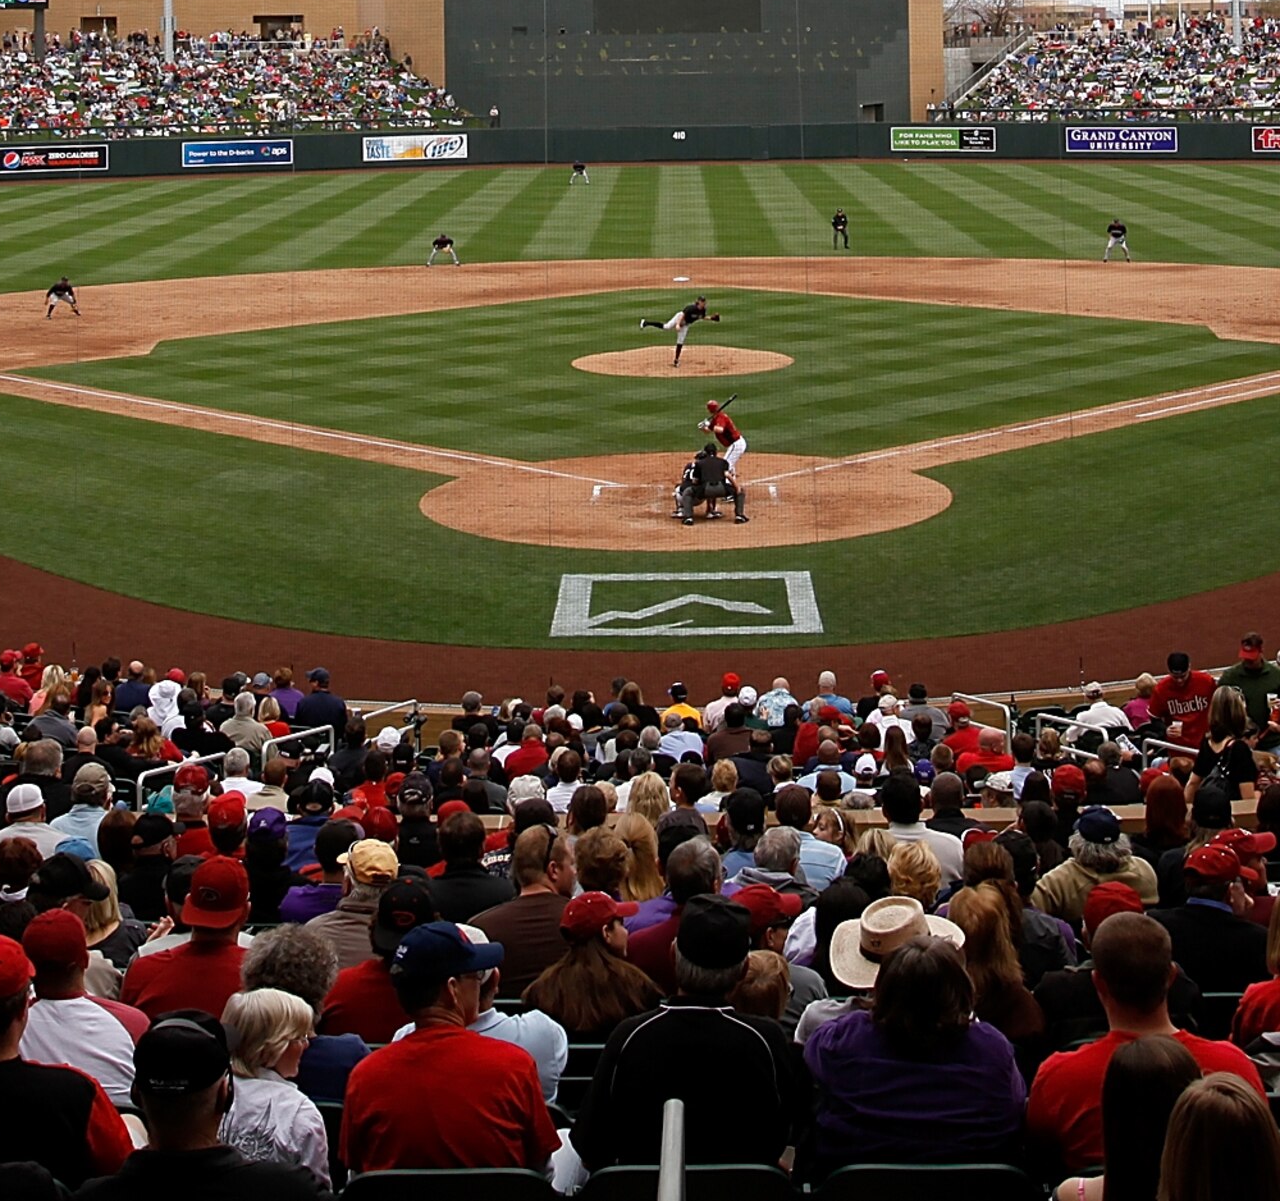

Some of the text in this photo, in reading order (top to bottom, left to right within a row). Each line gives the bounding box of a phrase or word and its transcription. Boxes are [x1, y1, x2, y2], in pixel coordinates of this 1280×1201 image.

[1071, 129, 1172, 141] GRAND CANYON
[1089, 141, 1152, 150] UNIVERSITY
[48, 151, 99, 160] ZERO CALORIES
[271, 147, 287, 157] aps
[366, 145, 391, 159] TASTE
